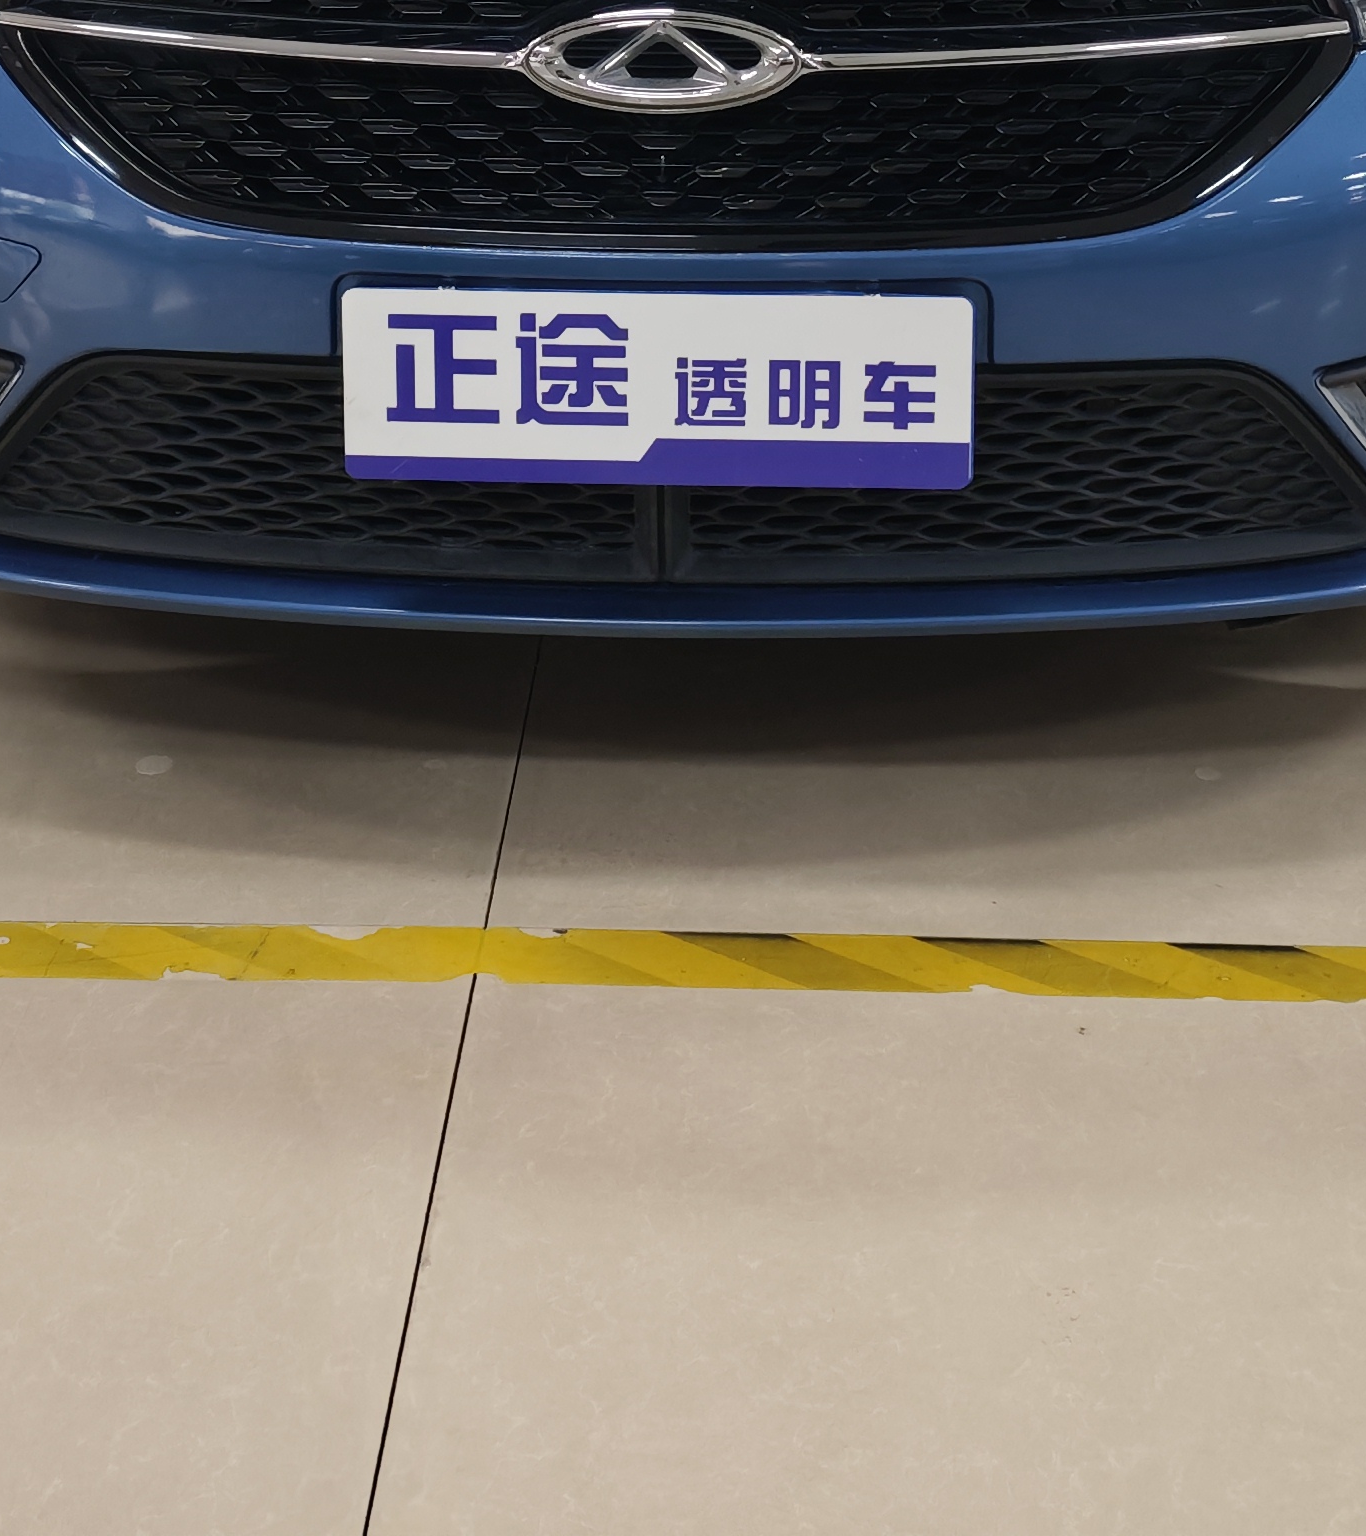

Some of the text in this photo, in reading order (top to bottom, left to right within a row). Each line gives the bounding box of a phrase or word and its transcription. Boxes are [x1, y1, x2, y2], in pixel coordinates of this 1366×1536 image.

[386, 313, 937, 430] 正途 透明车
